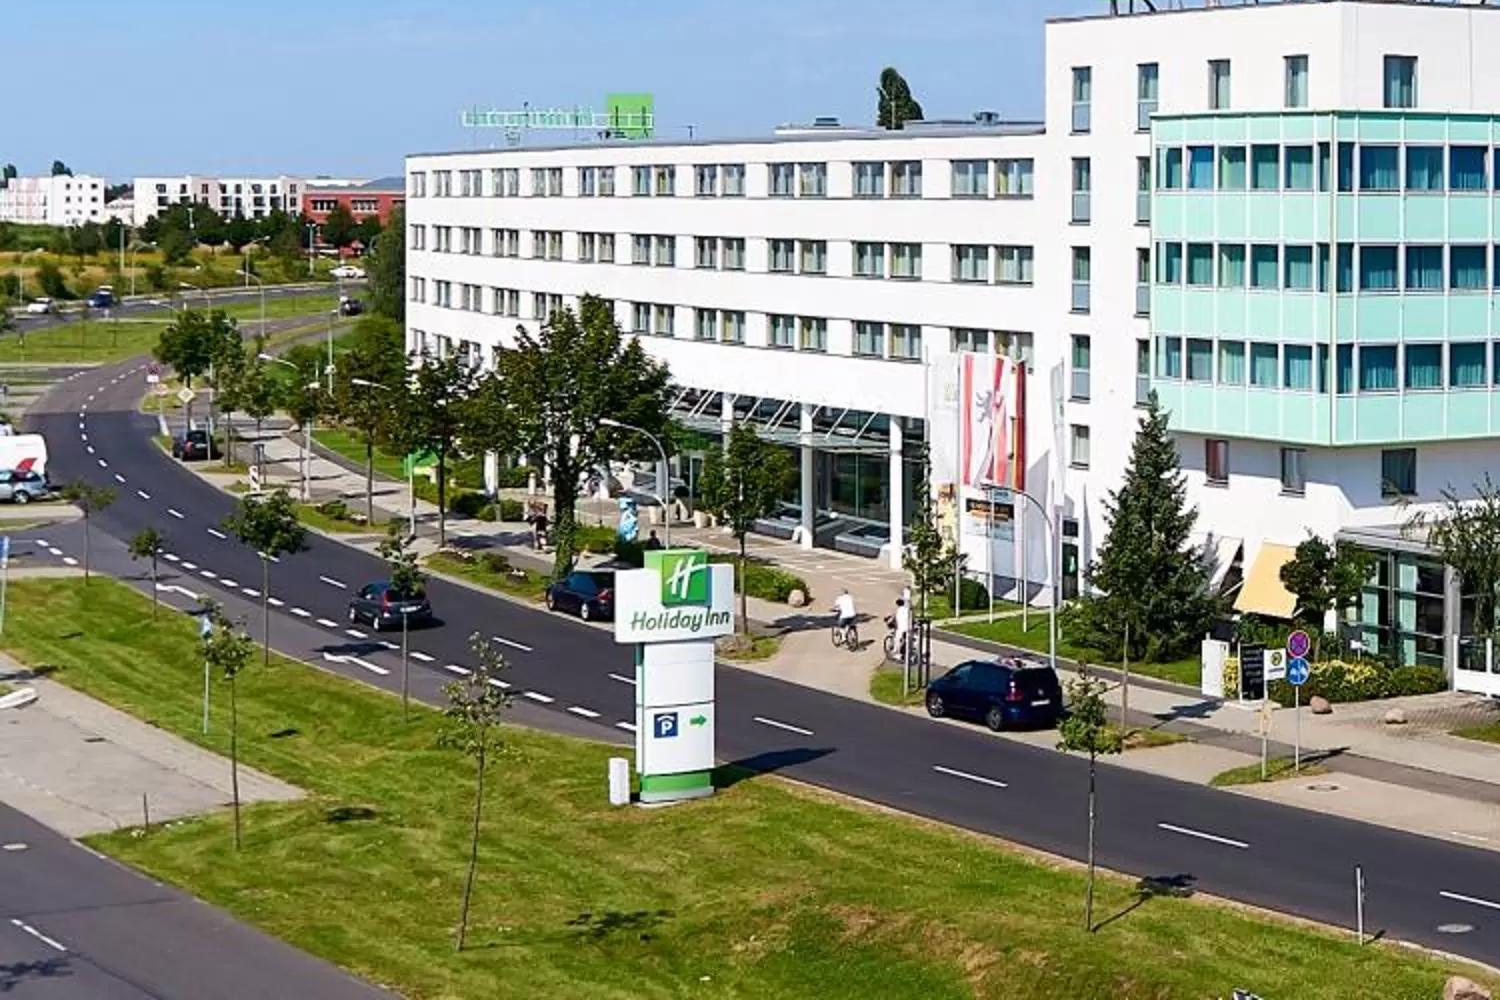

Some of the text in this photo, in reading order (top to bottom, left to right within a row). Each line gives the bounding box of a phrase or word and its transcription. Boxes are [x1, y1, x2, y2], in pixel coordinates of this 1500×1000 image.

[630, 606, 731, 633] Holiday Inn
[661, 721, 673, 735] P
